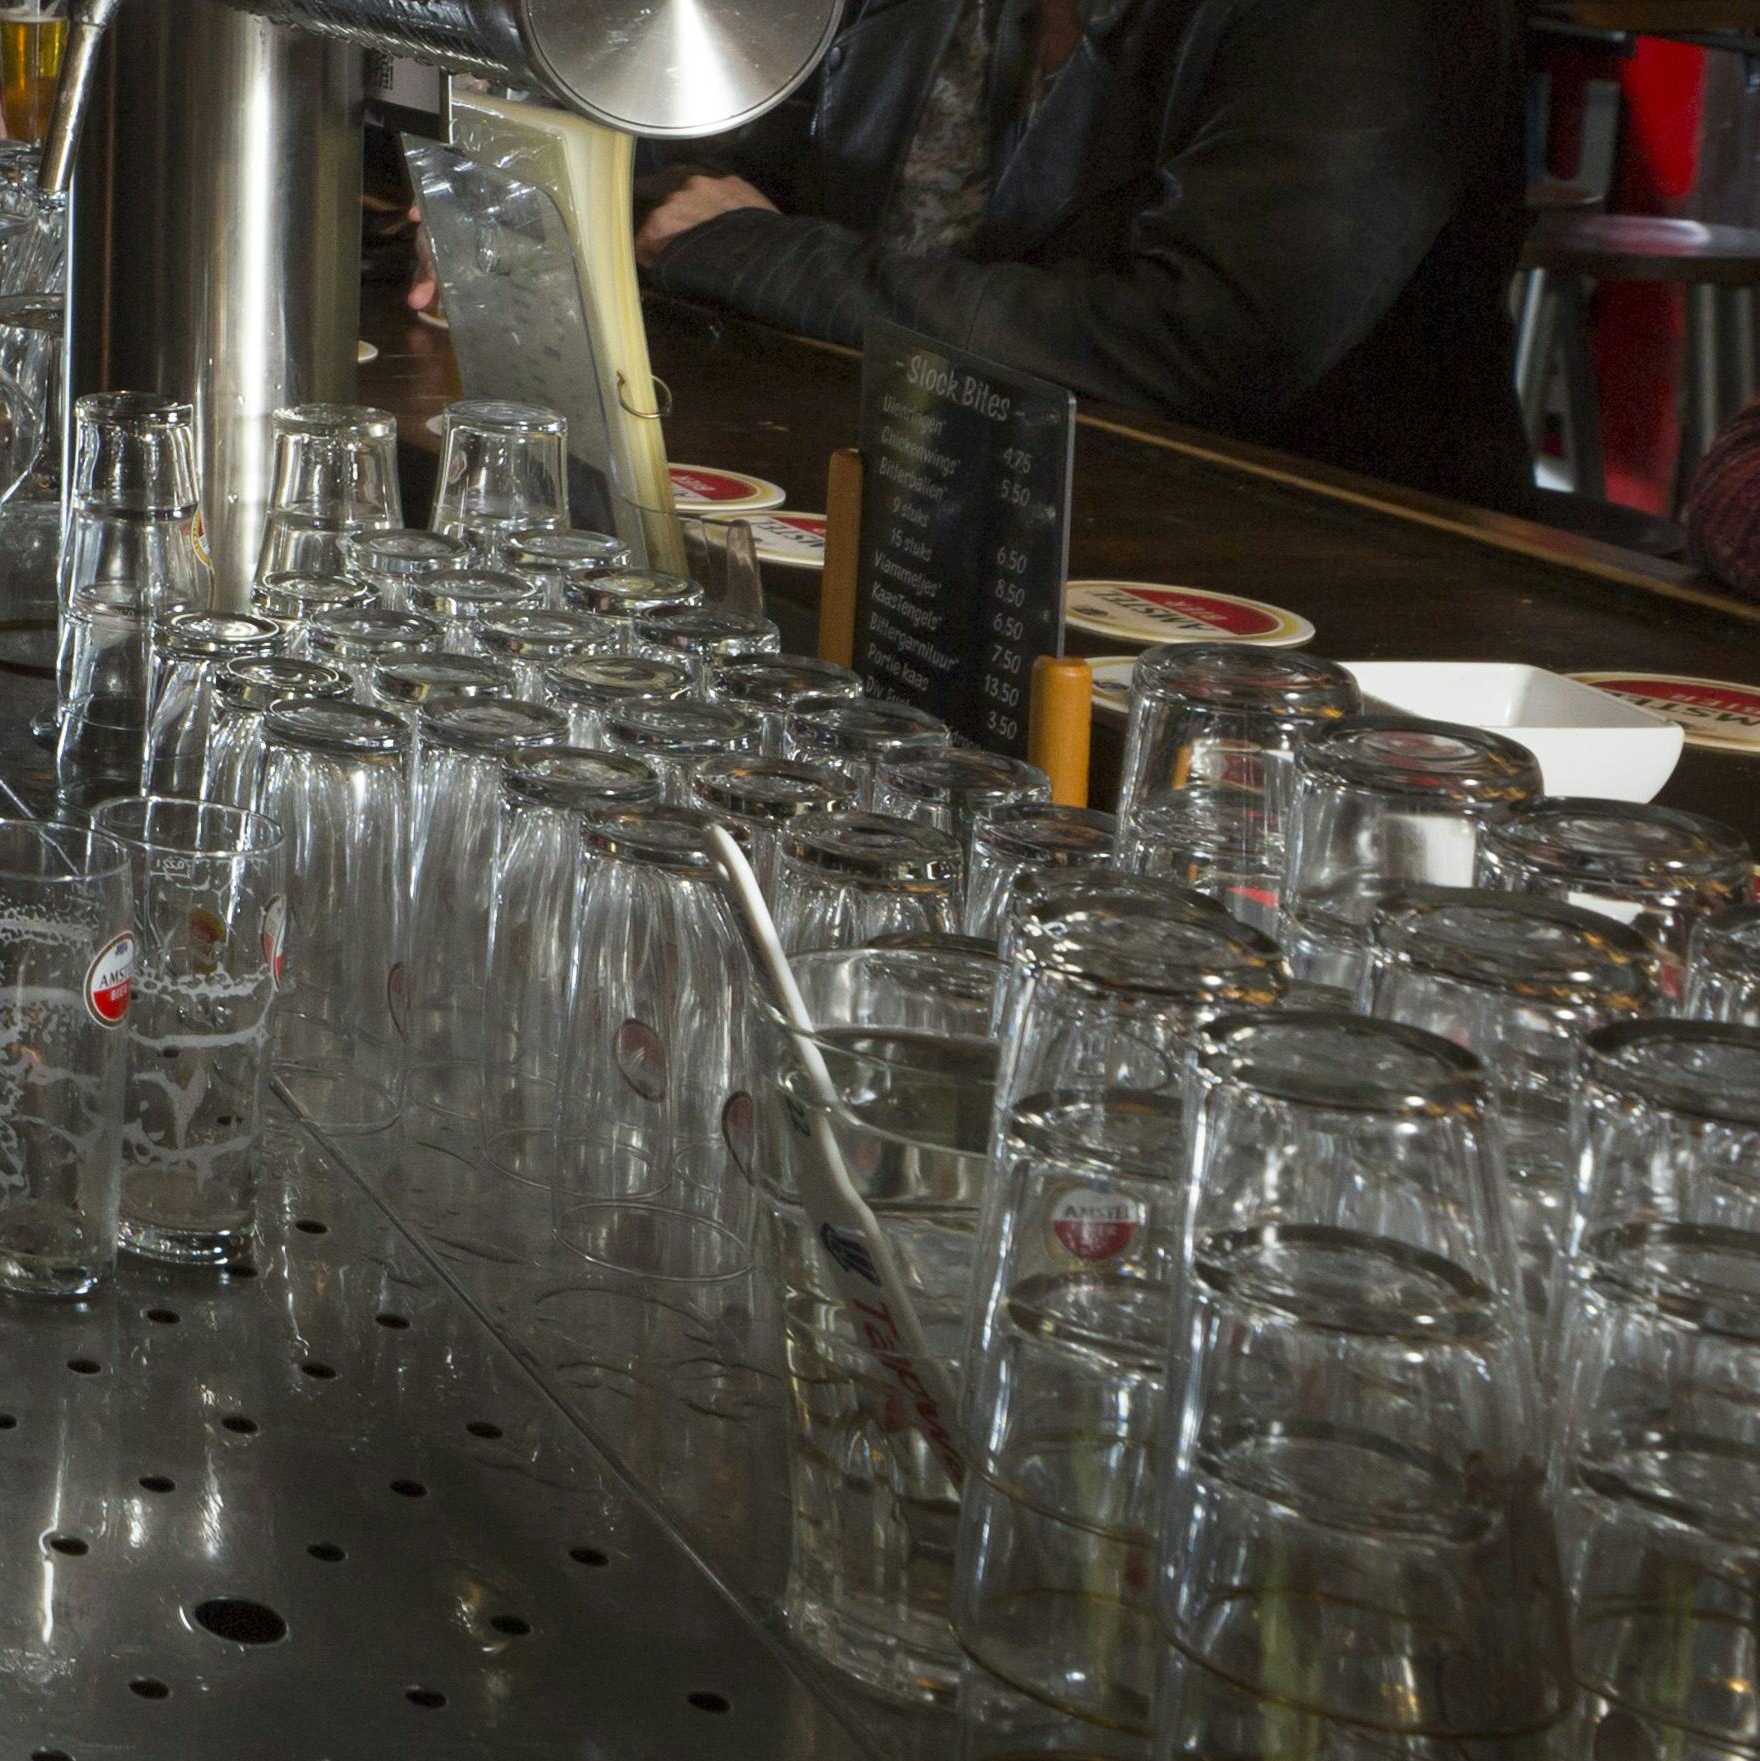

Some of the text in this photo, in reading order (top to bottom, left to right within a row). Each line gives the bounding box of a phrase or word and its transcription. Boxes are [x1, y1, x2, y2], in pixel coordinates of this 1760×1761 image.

[906, 353, 1012, 422] Slock Bites
[1002, 447, 1032, 474] 4.75
[1001, 479, 1030, 508] 5.50
[890, 527, 1026, 608] 15 stuks 8.50
[996, 545, 1028, 575] 6.50
[992, 612, 1024, 641] 6.50
[991, 644, 1022, 674] 7.50
[867, 642, 902, 676] Portie
[900, 664, 929, 692] kaas
[986, 710, 1019, 740] 3.50
[984, 673, 1020, 707] 13.50
